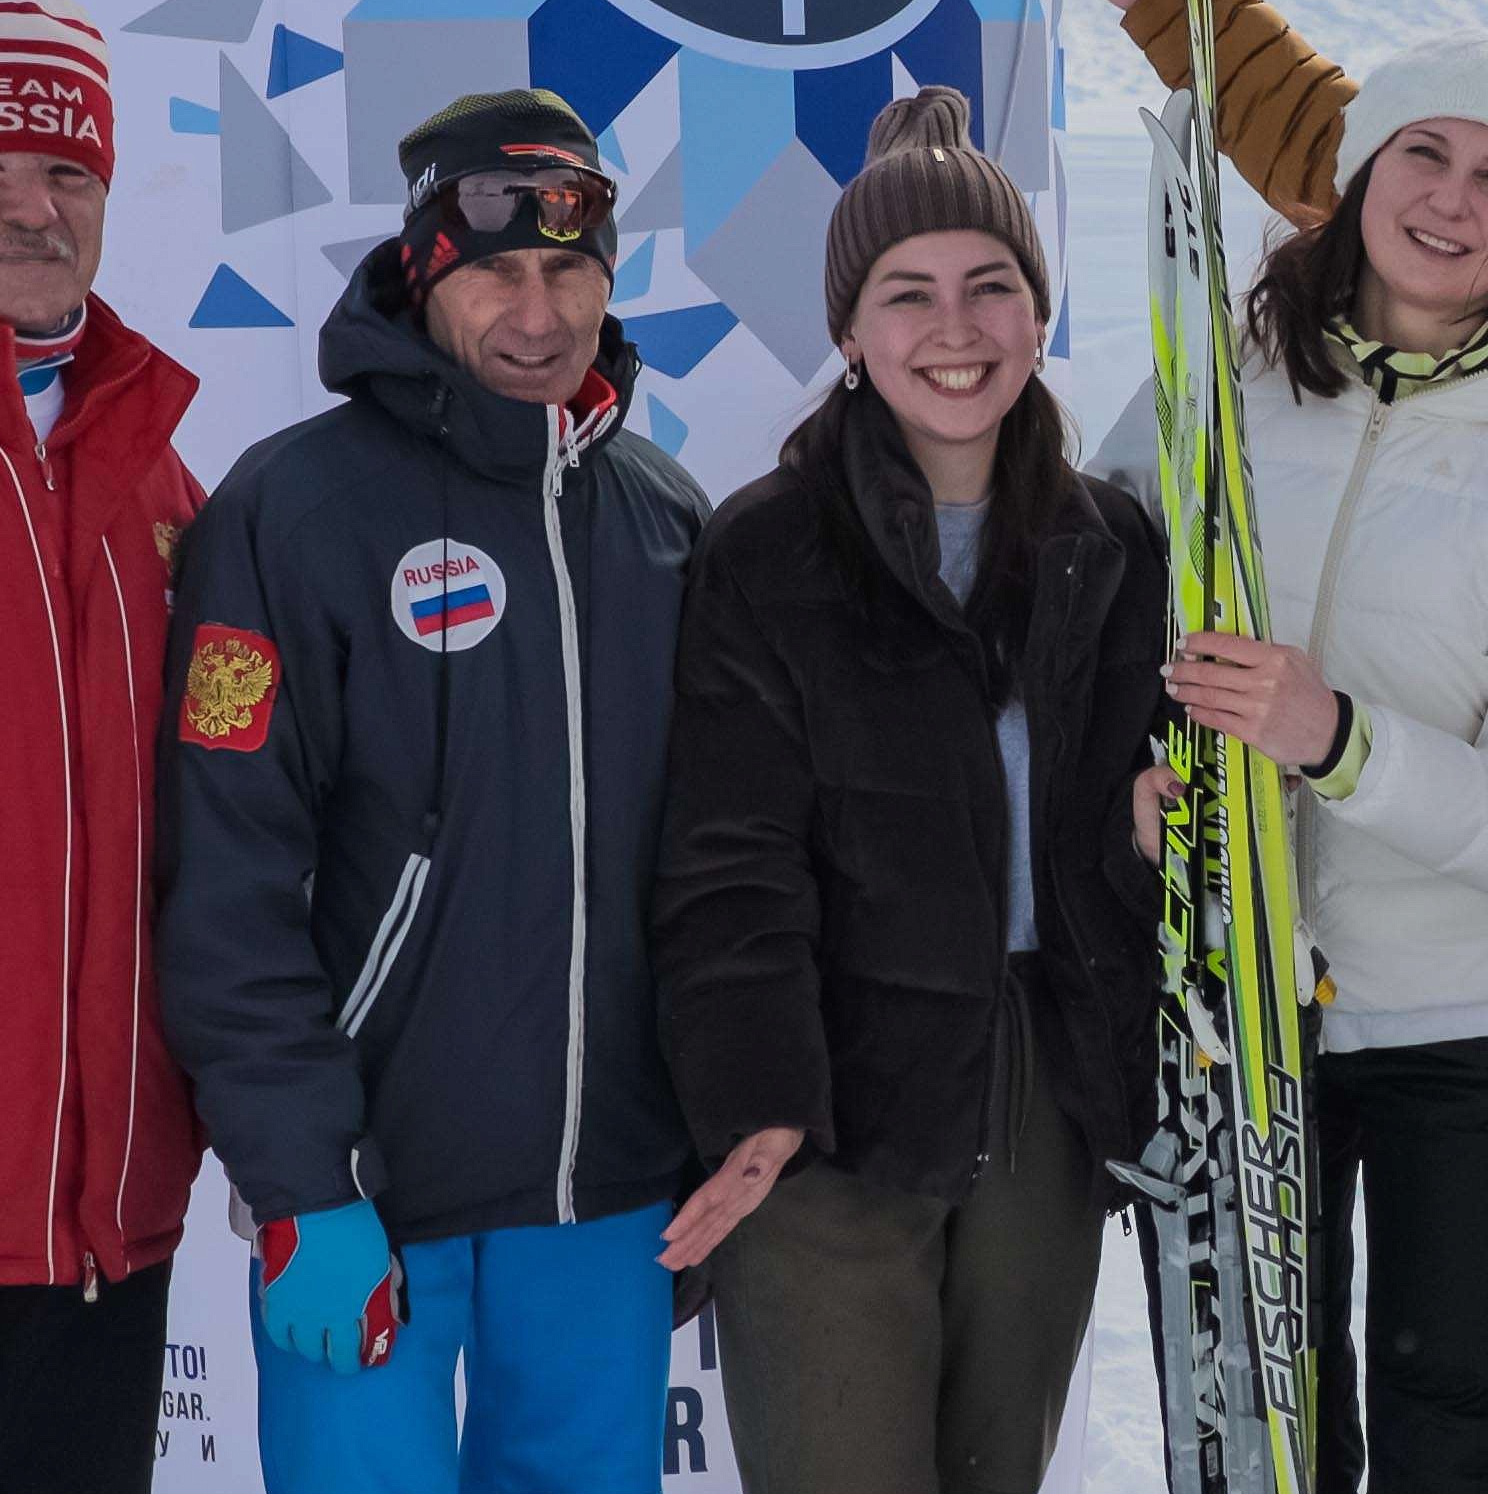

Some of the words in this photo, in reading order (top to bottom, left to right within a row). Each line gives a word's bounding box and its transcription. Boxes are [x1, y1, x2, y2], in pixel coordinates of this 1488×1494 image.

[403, 555, 481, 587] RUSSIA
[1241, 1118, 1298, 1420] FISCHER
[162, 1390, 211, 1422] GAR.
